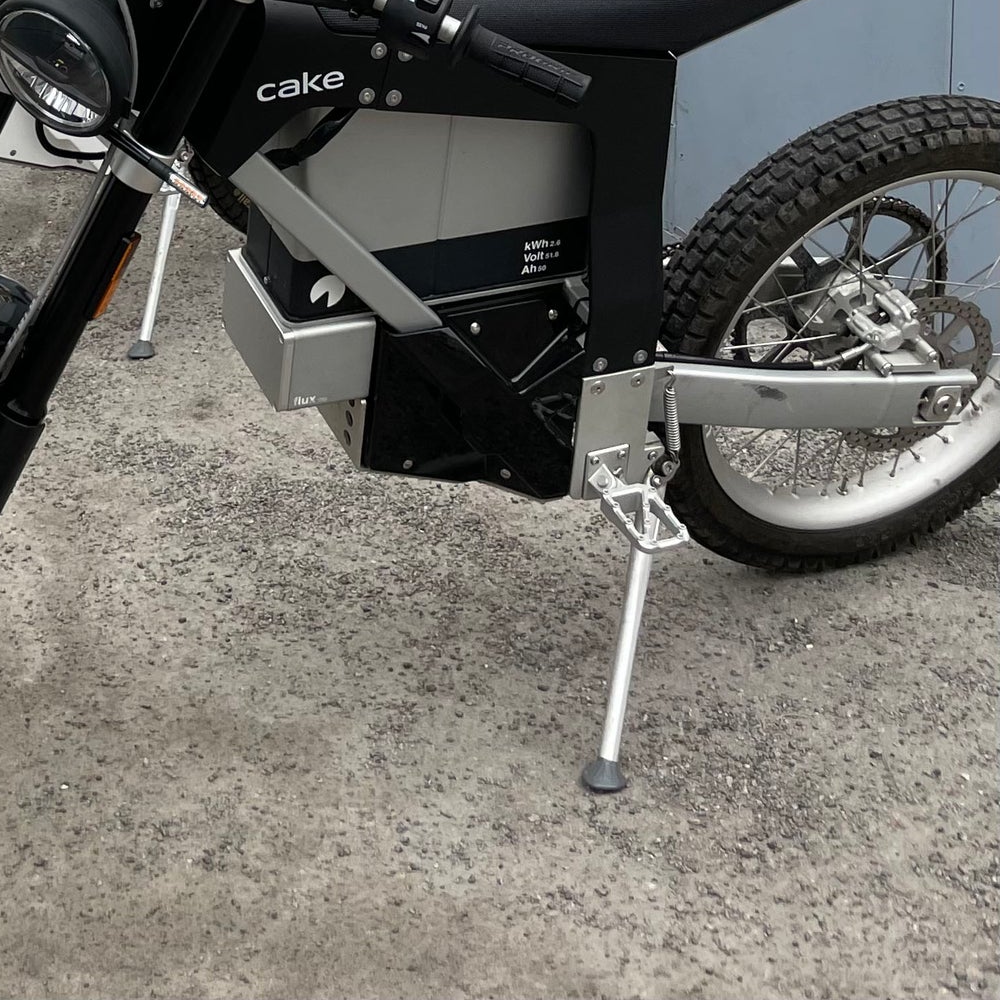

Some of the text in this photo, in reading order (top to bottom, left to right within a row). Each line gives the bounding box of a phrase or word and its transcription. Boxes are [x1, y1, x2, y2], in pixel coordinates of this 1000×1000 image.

[256, 70, 345, 102] cake
[524, 239, 549, 251] kWh
[523, 251, 545, 263] Volt
[521, 264, 537, 275] Ah
[293, 395, 317, 406] flux
